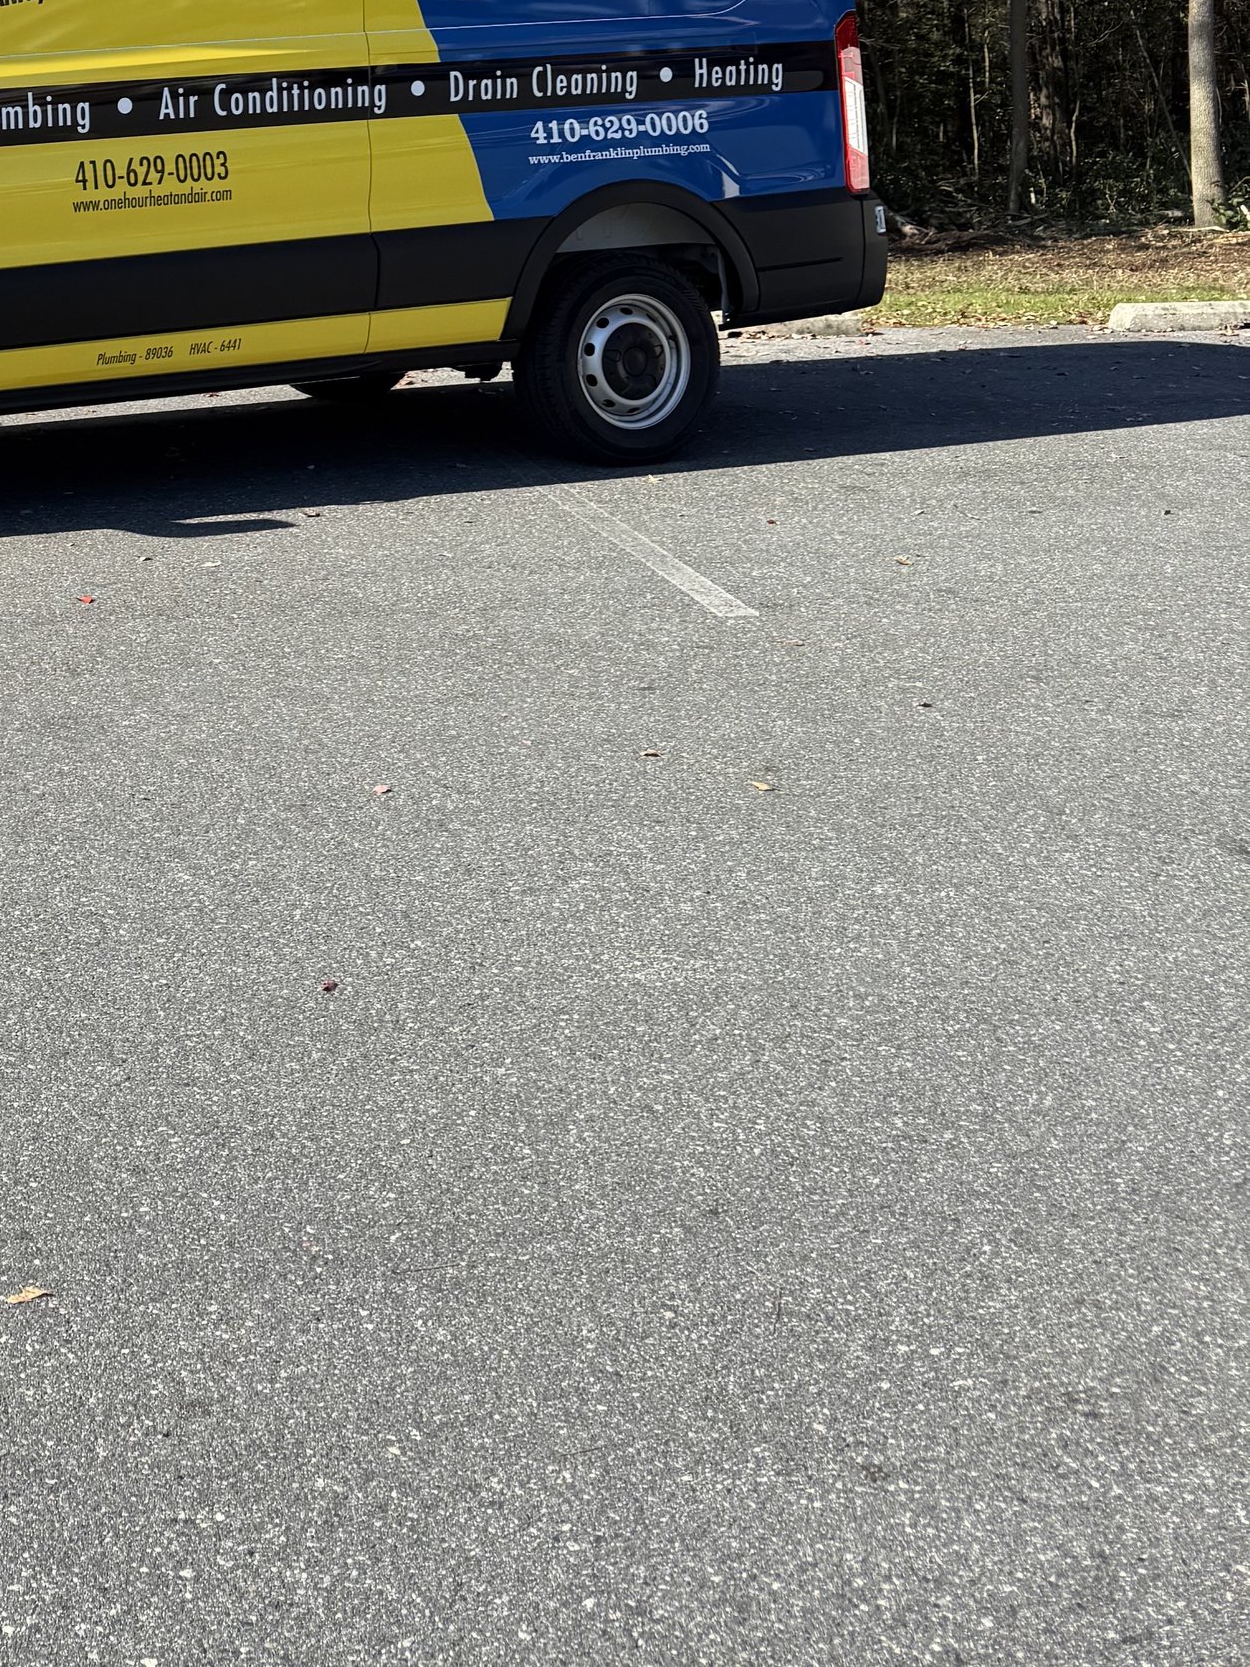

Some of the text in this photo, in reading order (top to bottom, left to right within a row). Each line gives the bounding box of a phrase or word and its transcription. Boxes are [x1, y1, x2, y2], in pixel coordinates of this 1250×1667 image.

[159, 87, 199, 120] Air
[213, 77, 387, 116] Conditioning
[449, 70, 518, 102] Drain
[531, 63, 638, 99] Cleaning
[694, 57, 784, 91] Heating
[530, 110, 710, 145] 410-629-0006
[528, 142, 711, 165] www.benfranklinplumbing.com
[75, 150, 229, 191] 410-629-0003
[72, 186, 233, 213] www.onehourheatandair.com
[96, 350, 137, 366] Plumbing
[144, 345, 174, 361] 89036
[189, 341, 214, 356] HVAC
[219, 338, 242, 352] 6441
